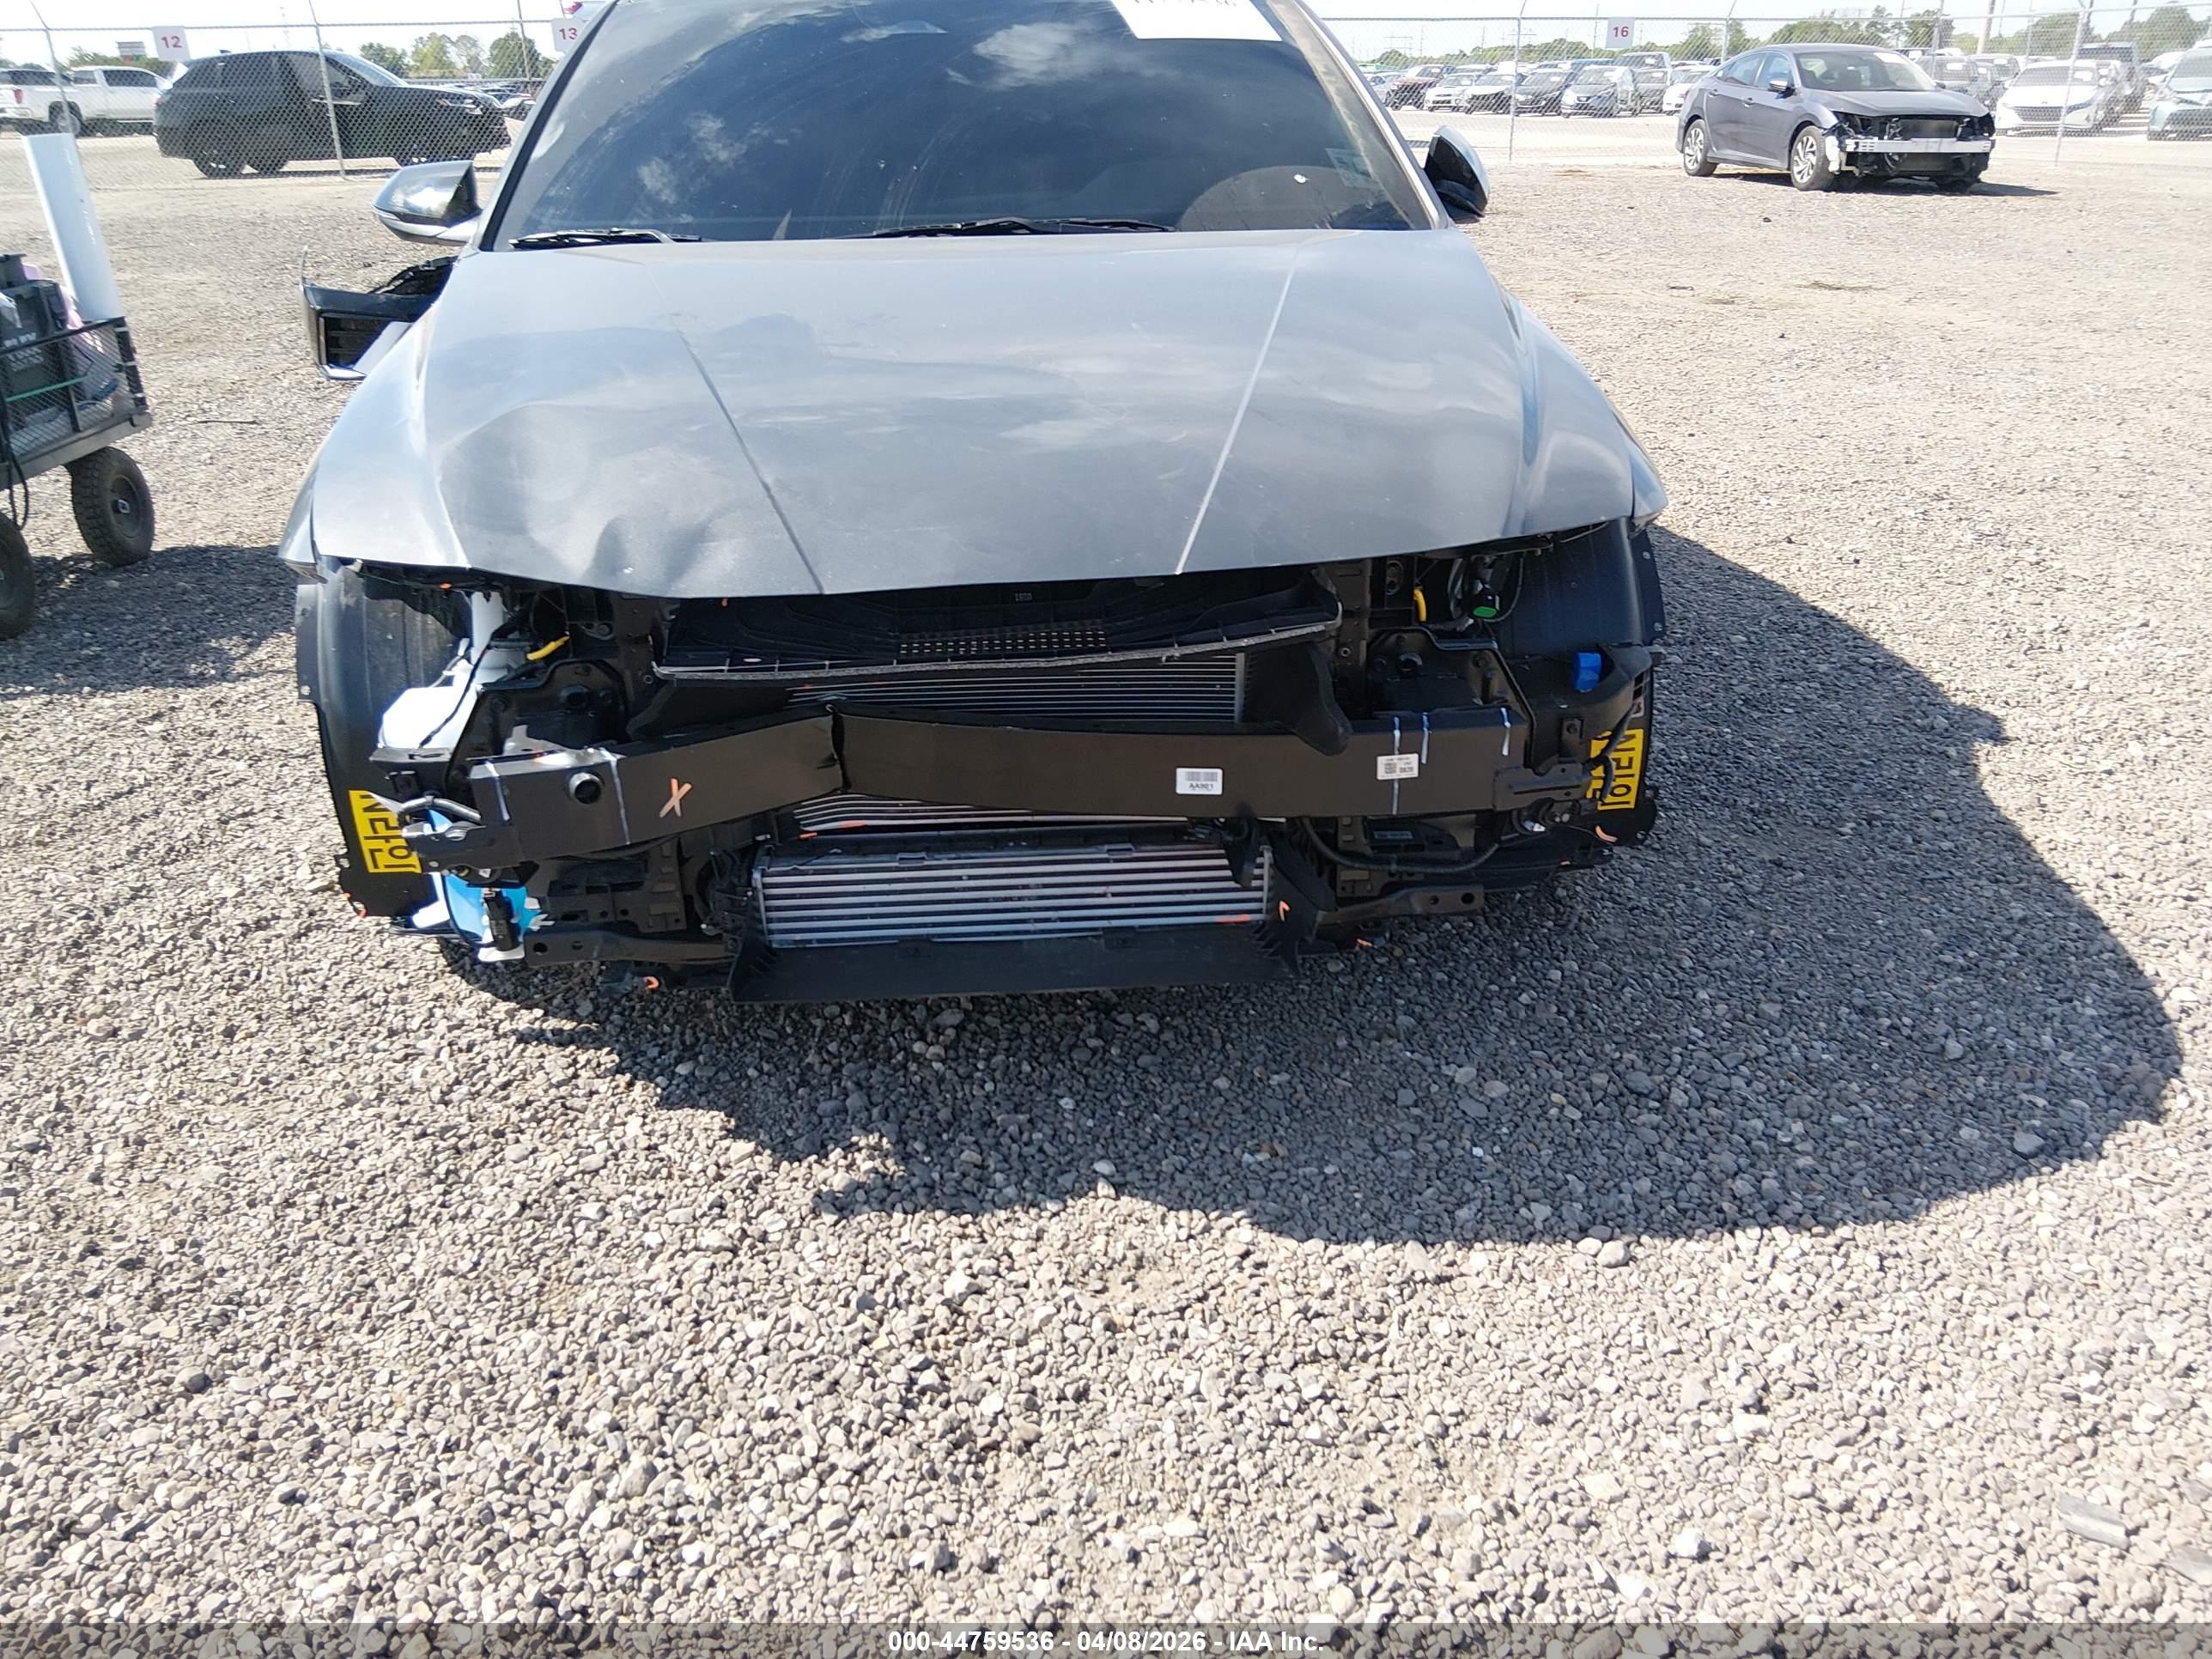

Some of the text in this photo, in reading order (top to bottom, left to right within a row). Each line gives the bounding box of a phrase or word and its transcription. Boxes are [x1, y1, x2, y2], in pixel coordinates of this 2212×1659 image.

[558, 27, 578, 40] 13
[1613, 26, 1629, 38] 16
[161, 35, 182, 49] 12
